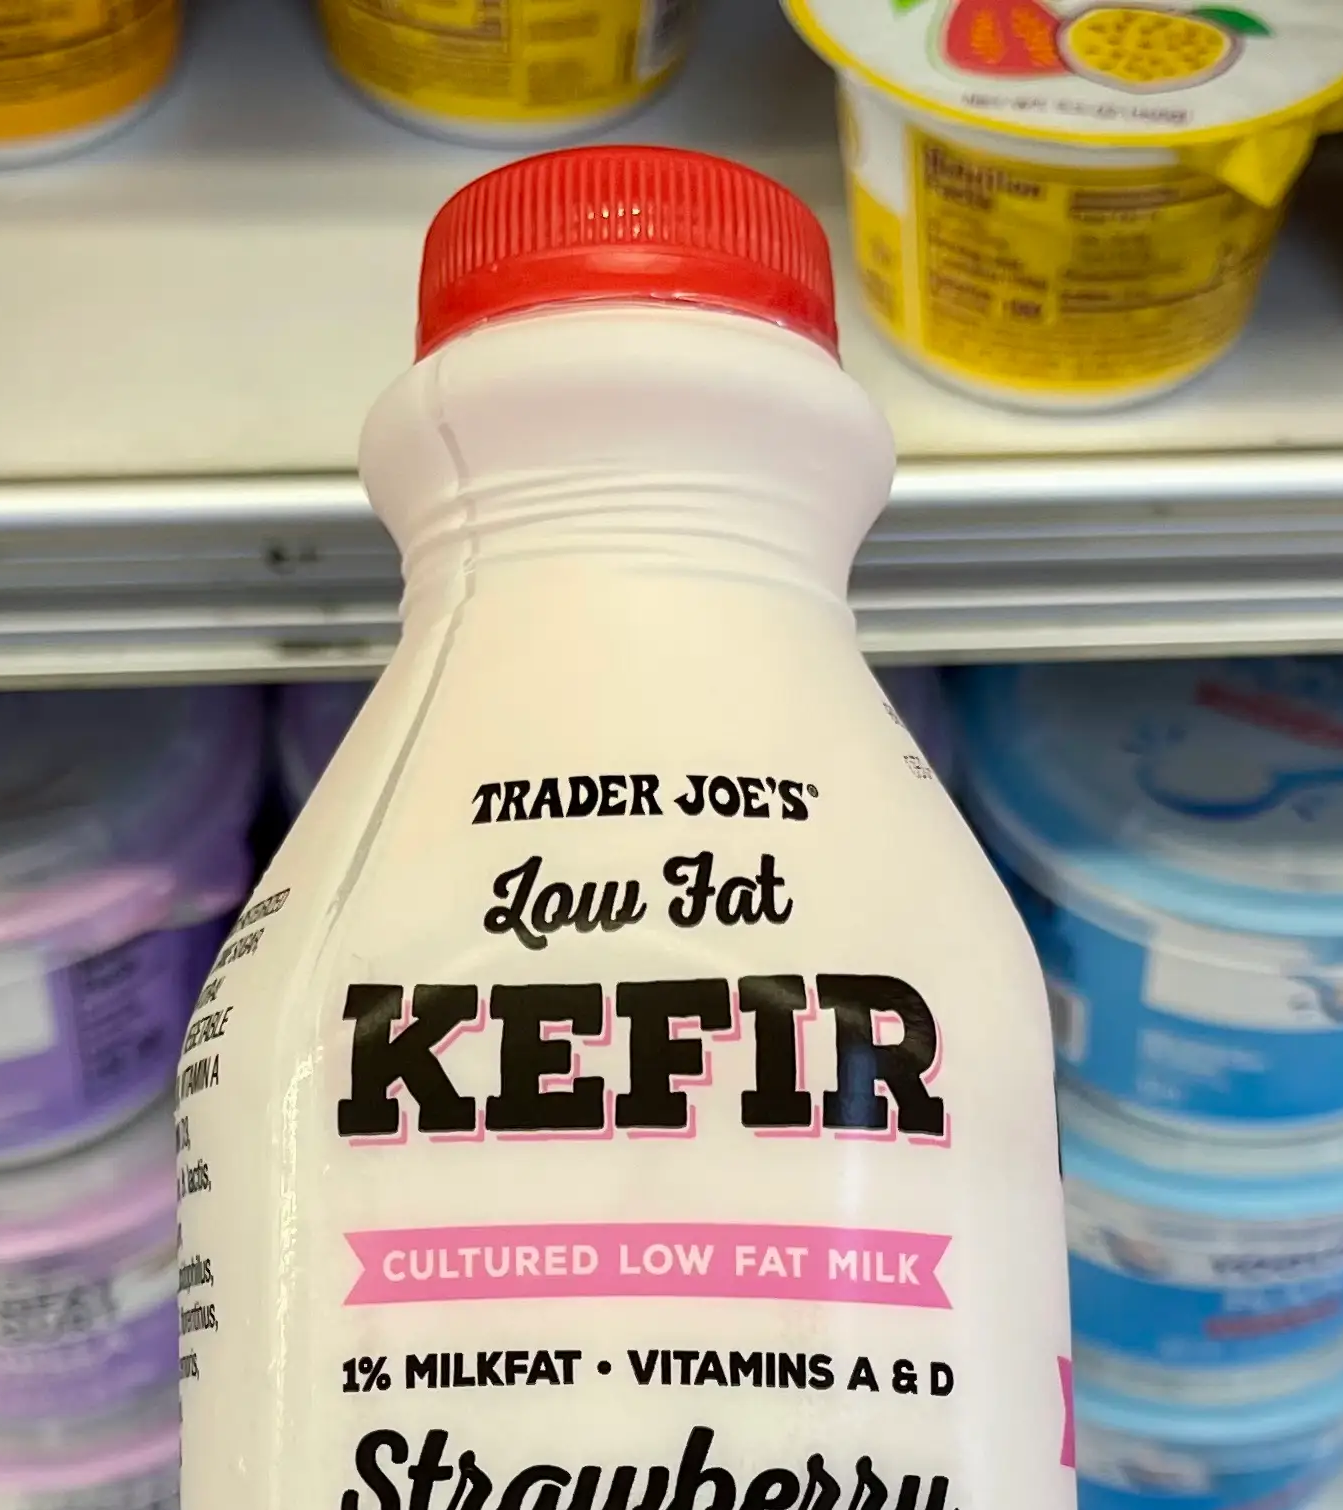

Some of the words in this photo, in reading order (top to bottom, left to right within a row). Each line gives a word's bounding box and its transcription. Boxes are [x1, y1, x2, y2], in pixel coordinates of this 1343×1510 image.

[471, 774, 663, 825] TRADER
[483, 855, 647, 950] Low
[662, 850, 794, 928] Fat
[337, 973, 949, 1147] KEFIR
[381, 1246, 600, 1283] CULTURED
[618, 1244, 715, 1277] LOW
[734, 1246, 810, 1278] FAT
[827, 1247, 921, 1286] MILK
[342, 1355, 392, 1393] 1%
[405, 1349, 582, 1390] MILKFAT
[626, 1349, 835, 1390] VITAMINS
[846, 1356, 880, 1393] A
[891, 1358, 918, 1395] &
[930, 1361, 954, 1397] D
